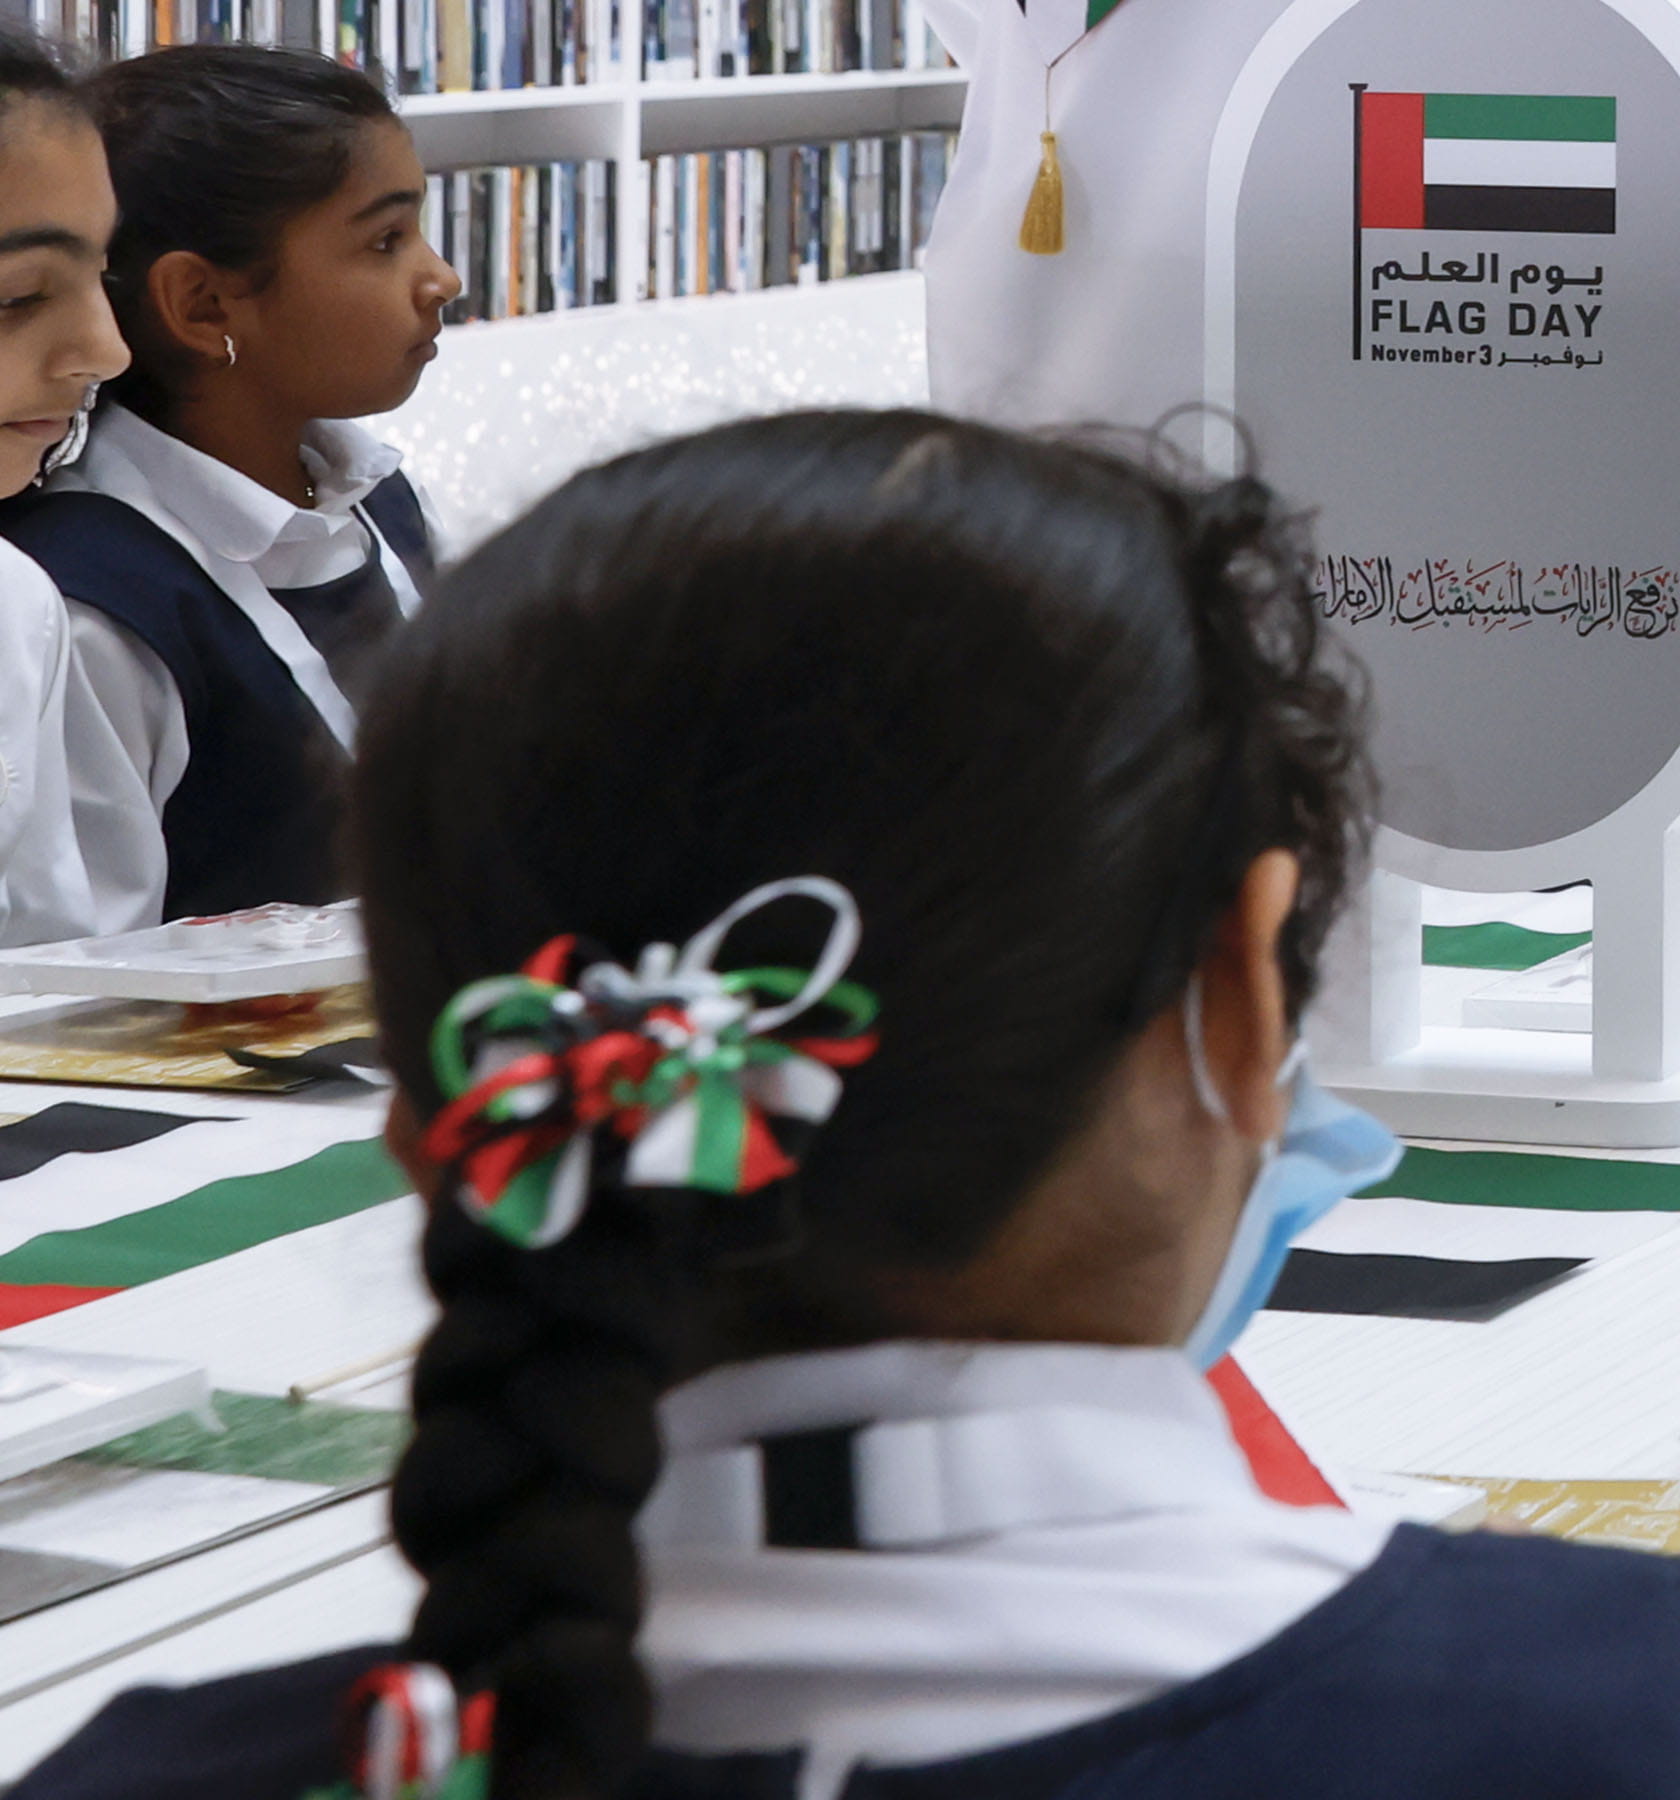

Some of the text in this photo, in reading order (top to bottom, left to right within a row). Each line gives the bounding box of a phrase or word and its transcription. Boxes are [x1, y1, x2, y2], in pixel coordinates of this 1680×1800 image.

[1371, 251, 1603, 296] يوم العلم
[1371, 299, 1603, 339] FLAG DAY
[1371, 344, 1603, 370] November 3 نوفمبر
